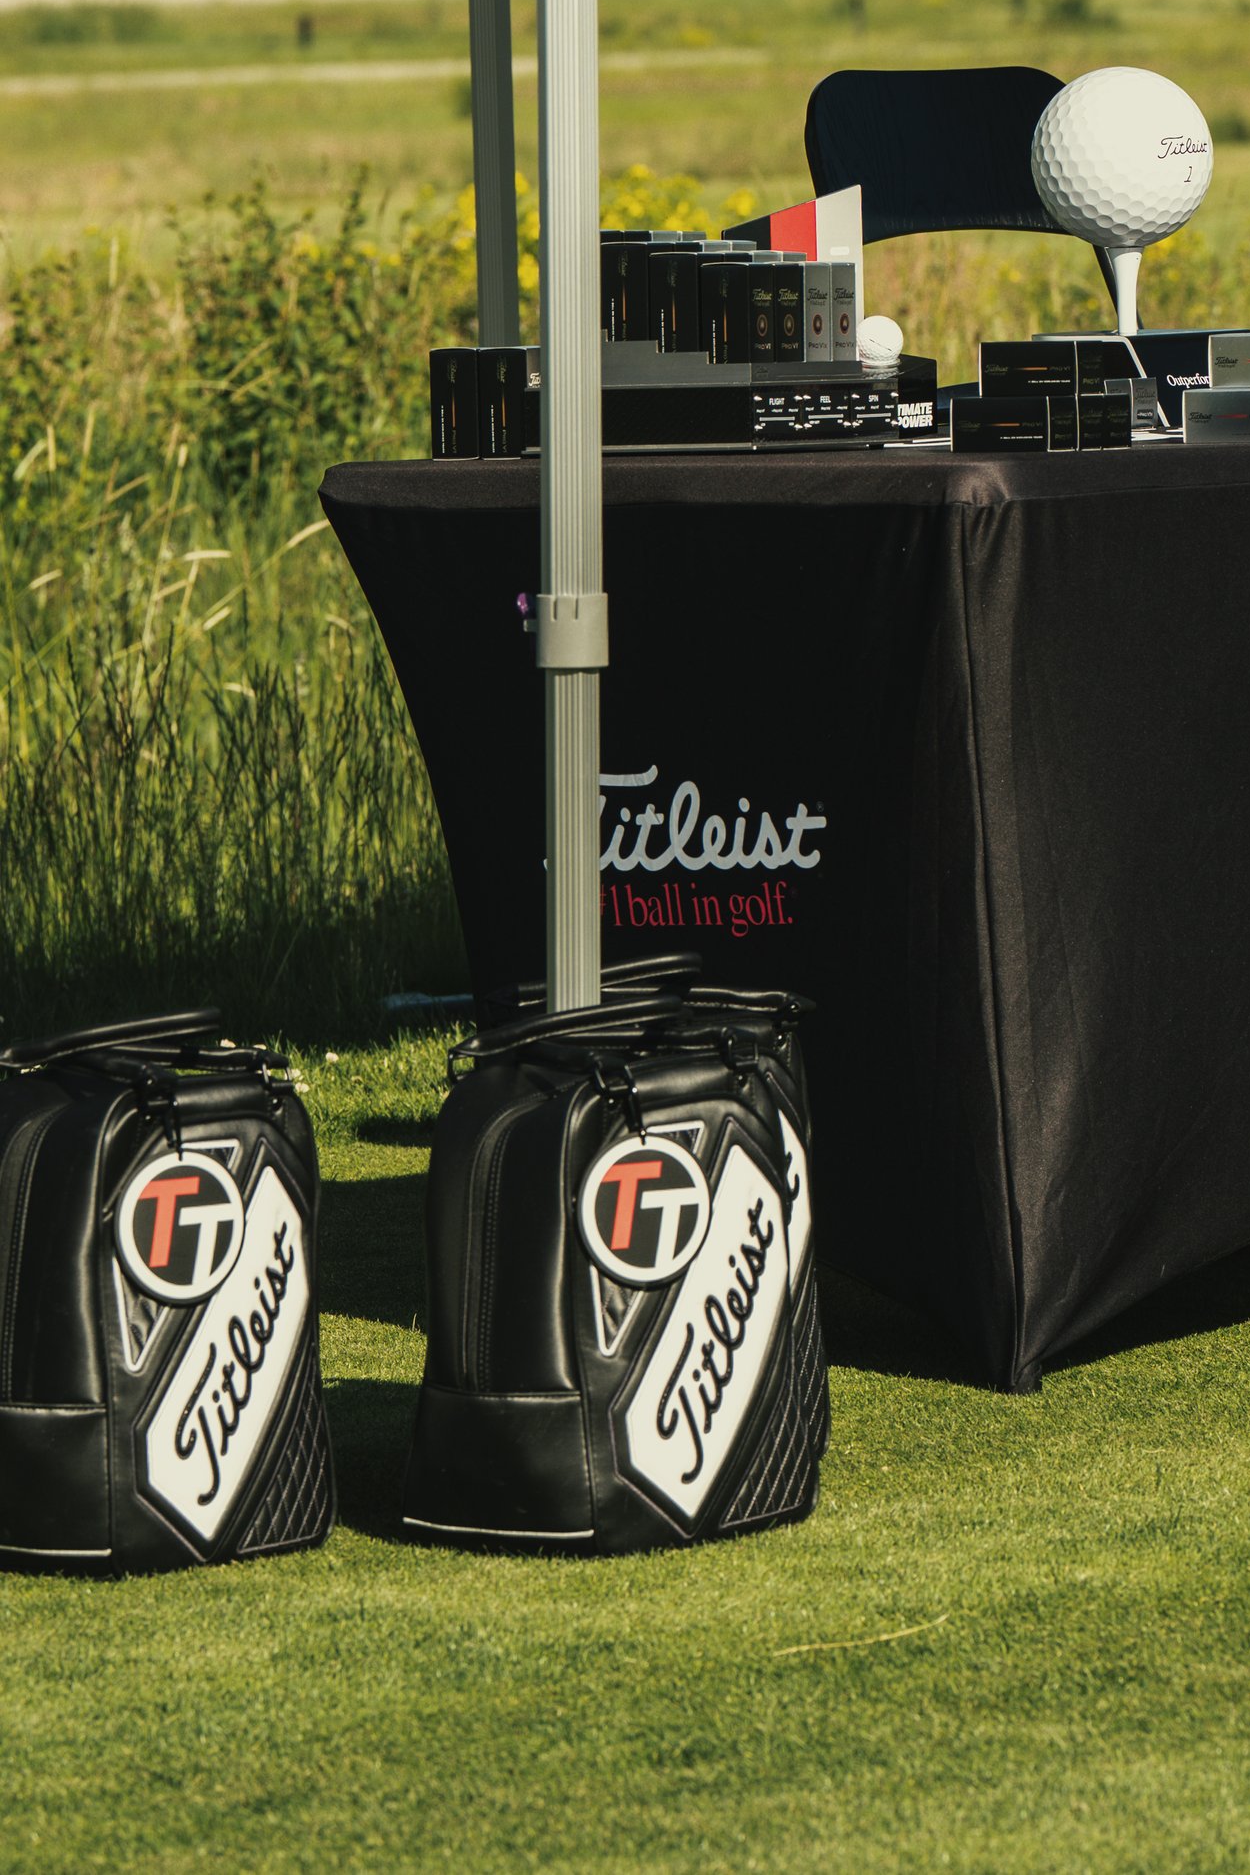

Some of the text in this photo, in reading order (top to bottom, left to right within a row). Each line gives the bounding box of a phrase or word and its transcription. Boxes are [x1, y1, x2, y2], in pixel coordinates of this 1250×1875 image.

[1157, 136, 1208, 160] Titleist
[1184, 166, 1193, 183] 1
[769, 398, 785, 406] FLIGHT
[820, 396, 831, 404] FEEL
[626, 882, 685, 926] ball
[691, 882, 722, 926] in
[729, 881, 793, 938] golf.
[656, 1197, 774, 1485] Titleist
[174, 1221, 294, 1506] Titleist
